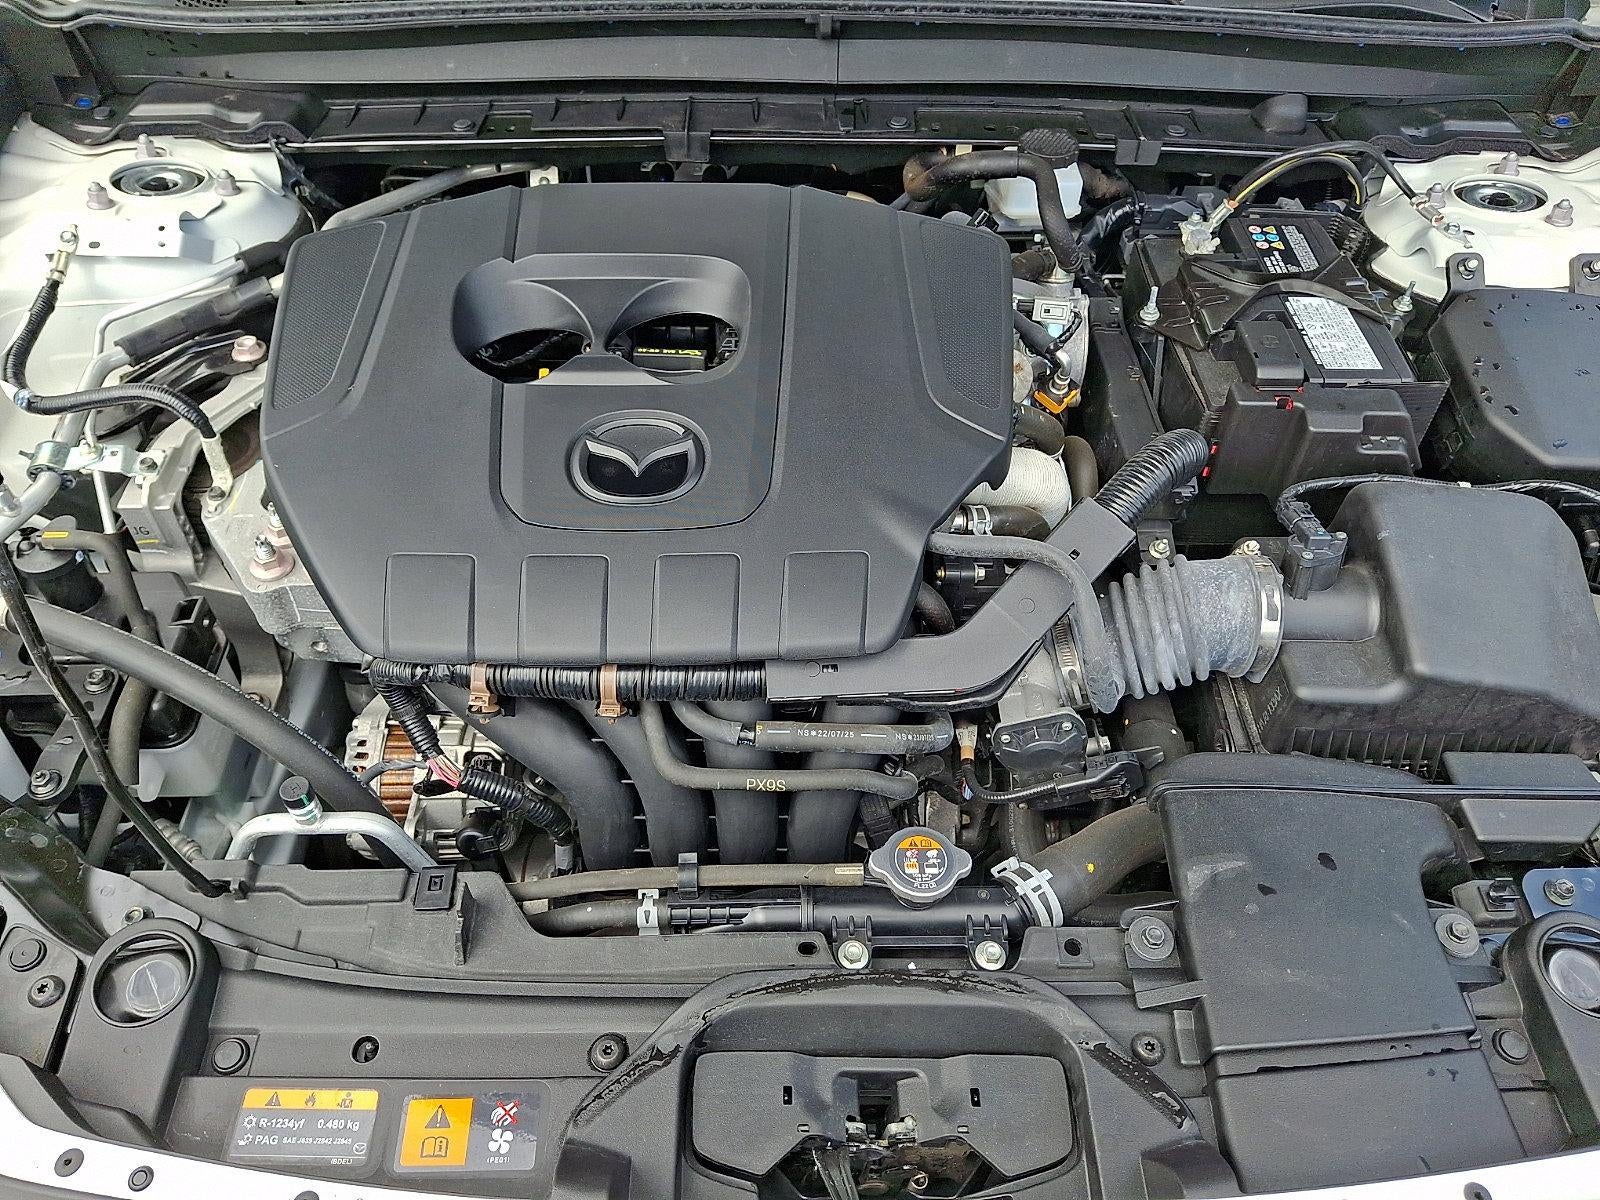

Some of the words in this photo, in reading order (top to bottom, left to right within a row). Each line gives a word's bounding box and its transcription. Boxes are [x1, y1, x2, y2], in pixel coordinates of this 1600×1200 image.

[746, 778, 786, 792] PX9S
[258, 1117, 306, 1131] R-1234yf
[346, 1118, 360, 1132] kg
[254, 1134, 279, 1146] PAG
